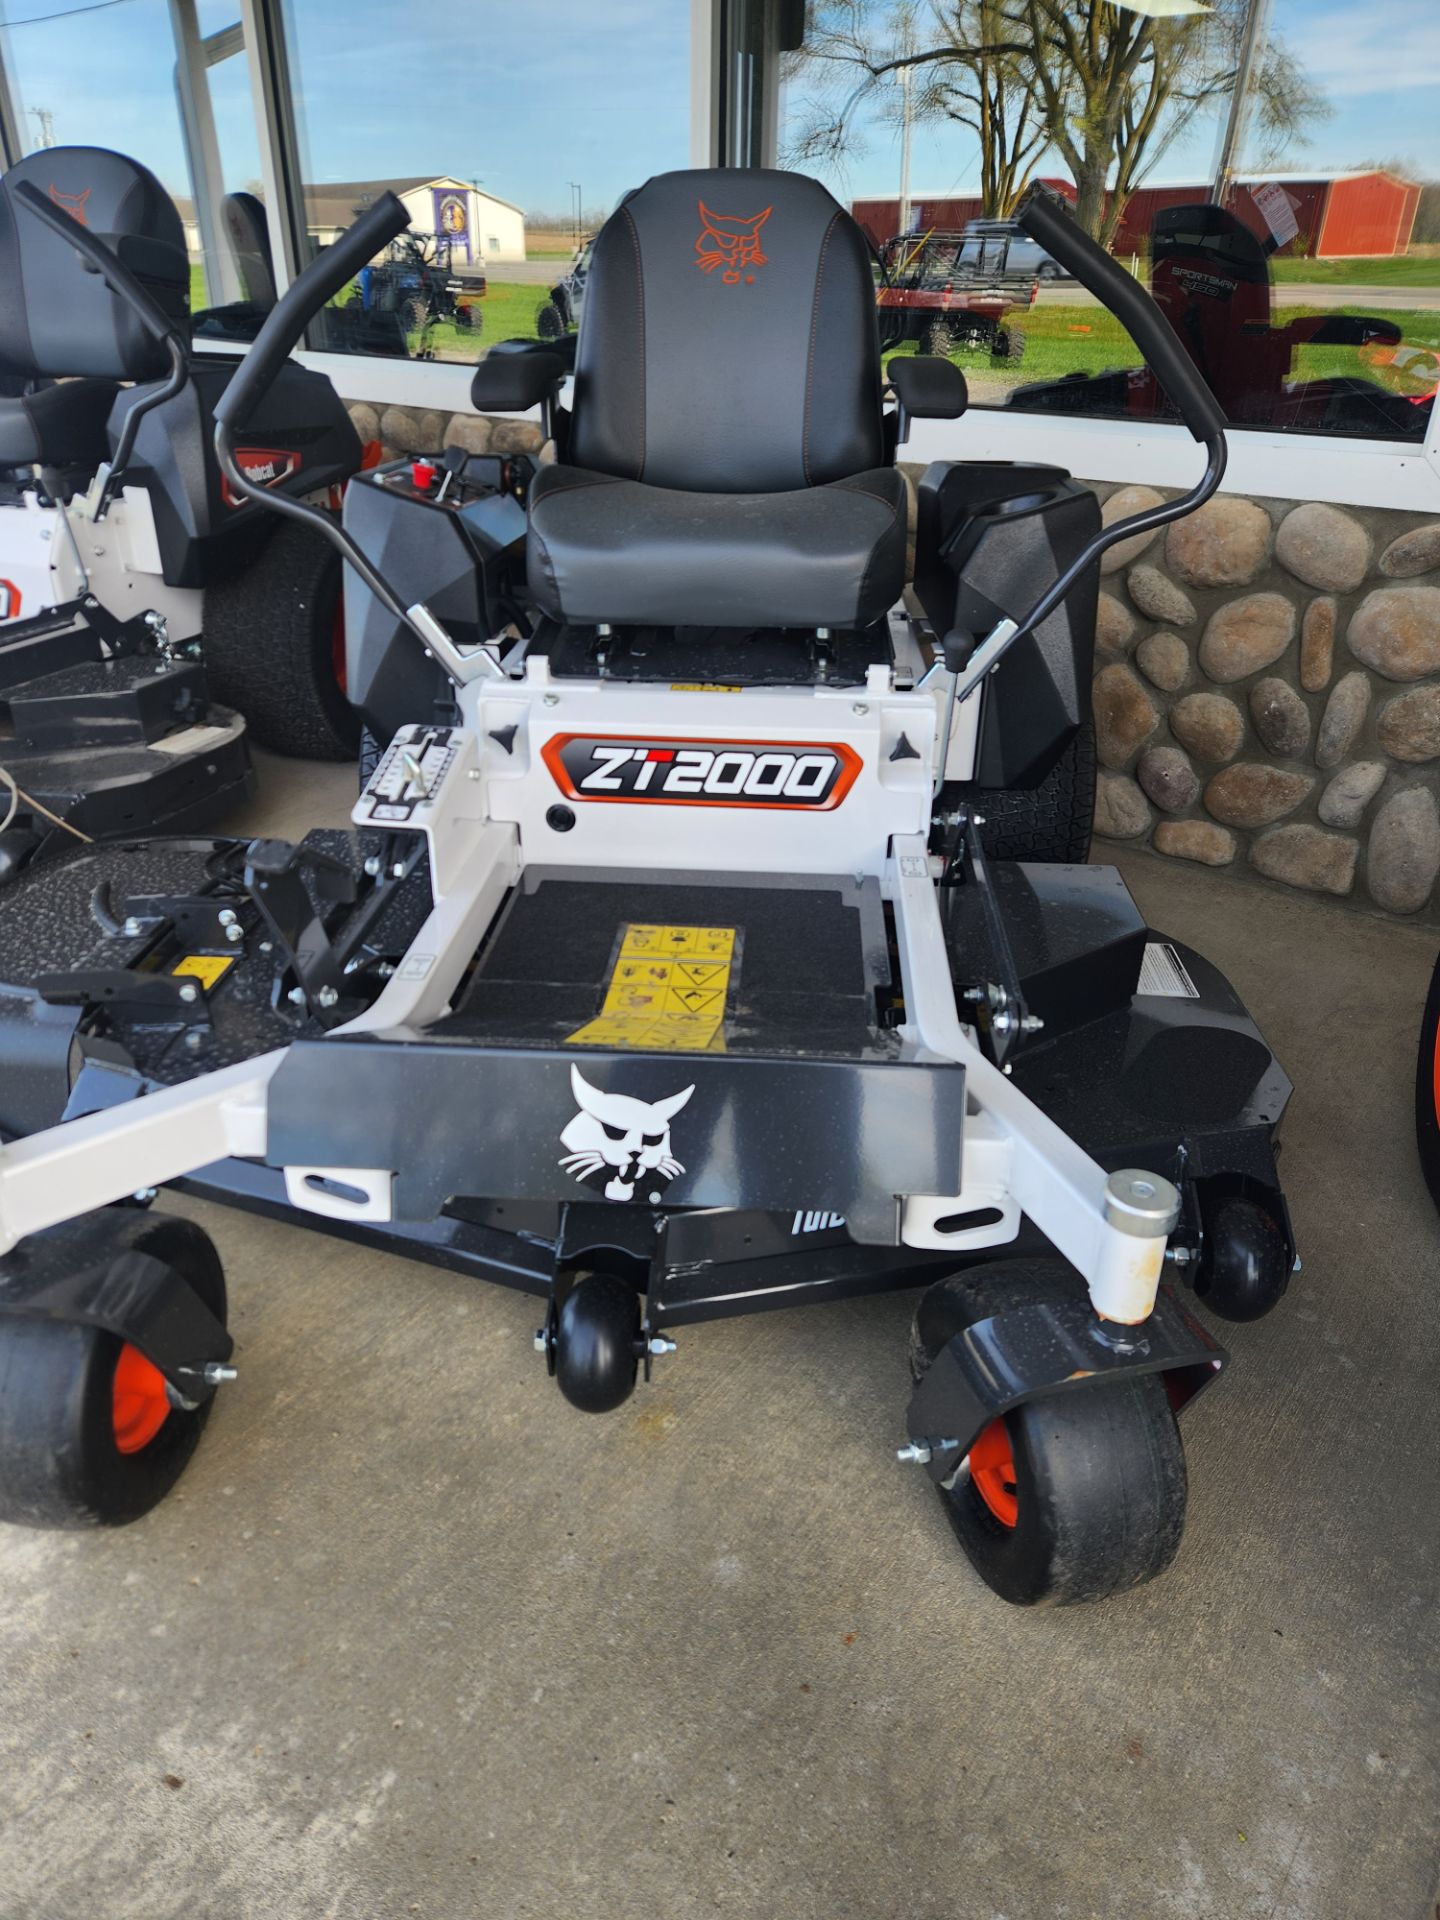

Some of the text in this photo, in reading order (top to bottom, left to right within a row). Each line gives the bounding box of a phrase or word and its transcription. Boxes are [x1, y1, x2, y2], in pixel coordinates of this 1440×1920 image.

[1171, 266, 1238, 291] SPORTSMAN
[1183, 280, 1219, 297] 450
[579, 746, 839, 798] ZT2000
